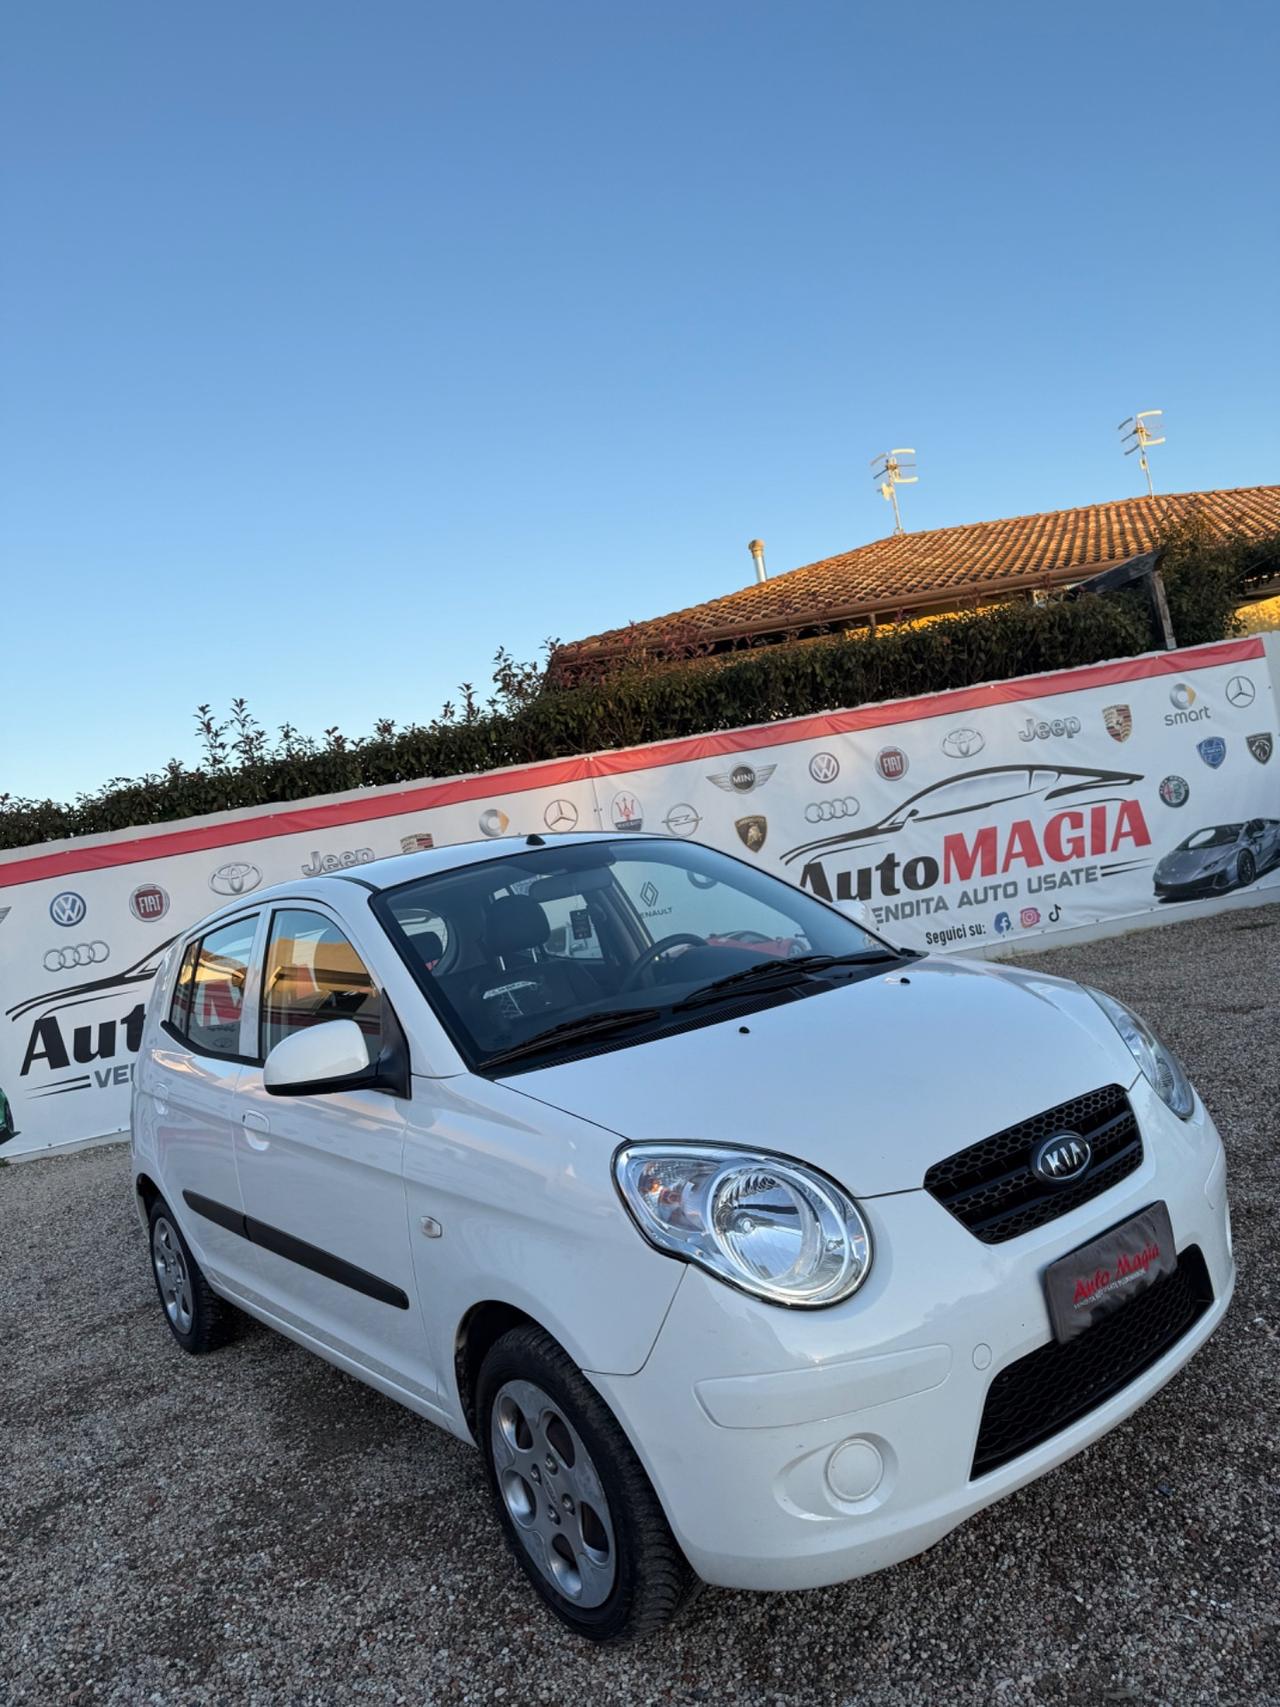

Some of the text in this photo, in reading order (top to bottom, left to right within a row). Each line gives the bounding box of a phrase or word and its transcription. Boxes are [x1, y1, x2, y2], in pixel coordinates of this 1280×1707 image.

[1018, 715, 1081, 742] Jeep
[1164, 705, 1211, 727] smart
[882, 755, 902, 773] FIAT
[732, 773, 754, 784] MINI
[138, 894, 161, 914] FIAT
[872, 864, 1098, 924] ENDITA AUTO USATE
[925, 922, 987, 947] Seguici su:
[1045, 1142, 1083, 1175] KIA
[1072, 1269, 1111, 1304] Auto
[1115, 1242, 1160, 1279] Magia
